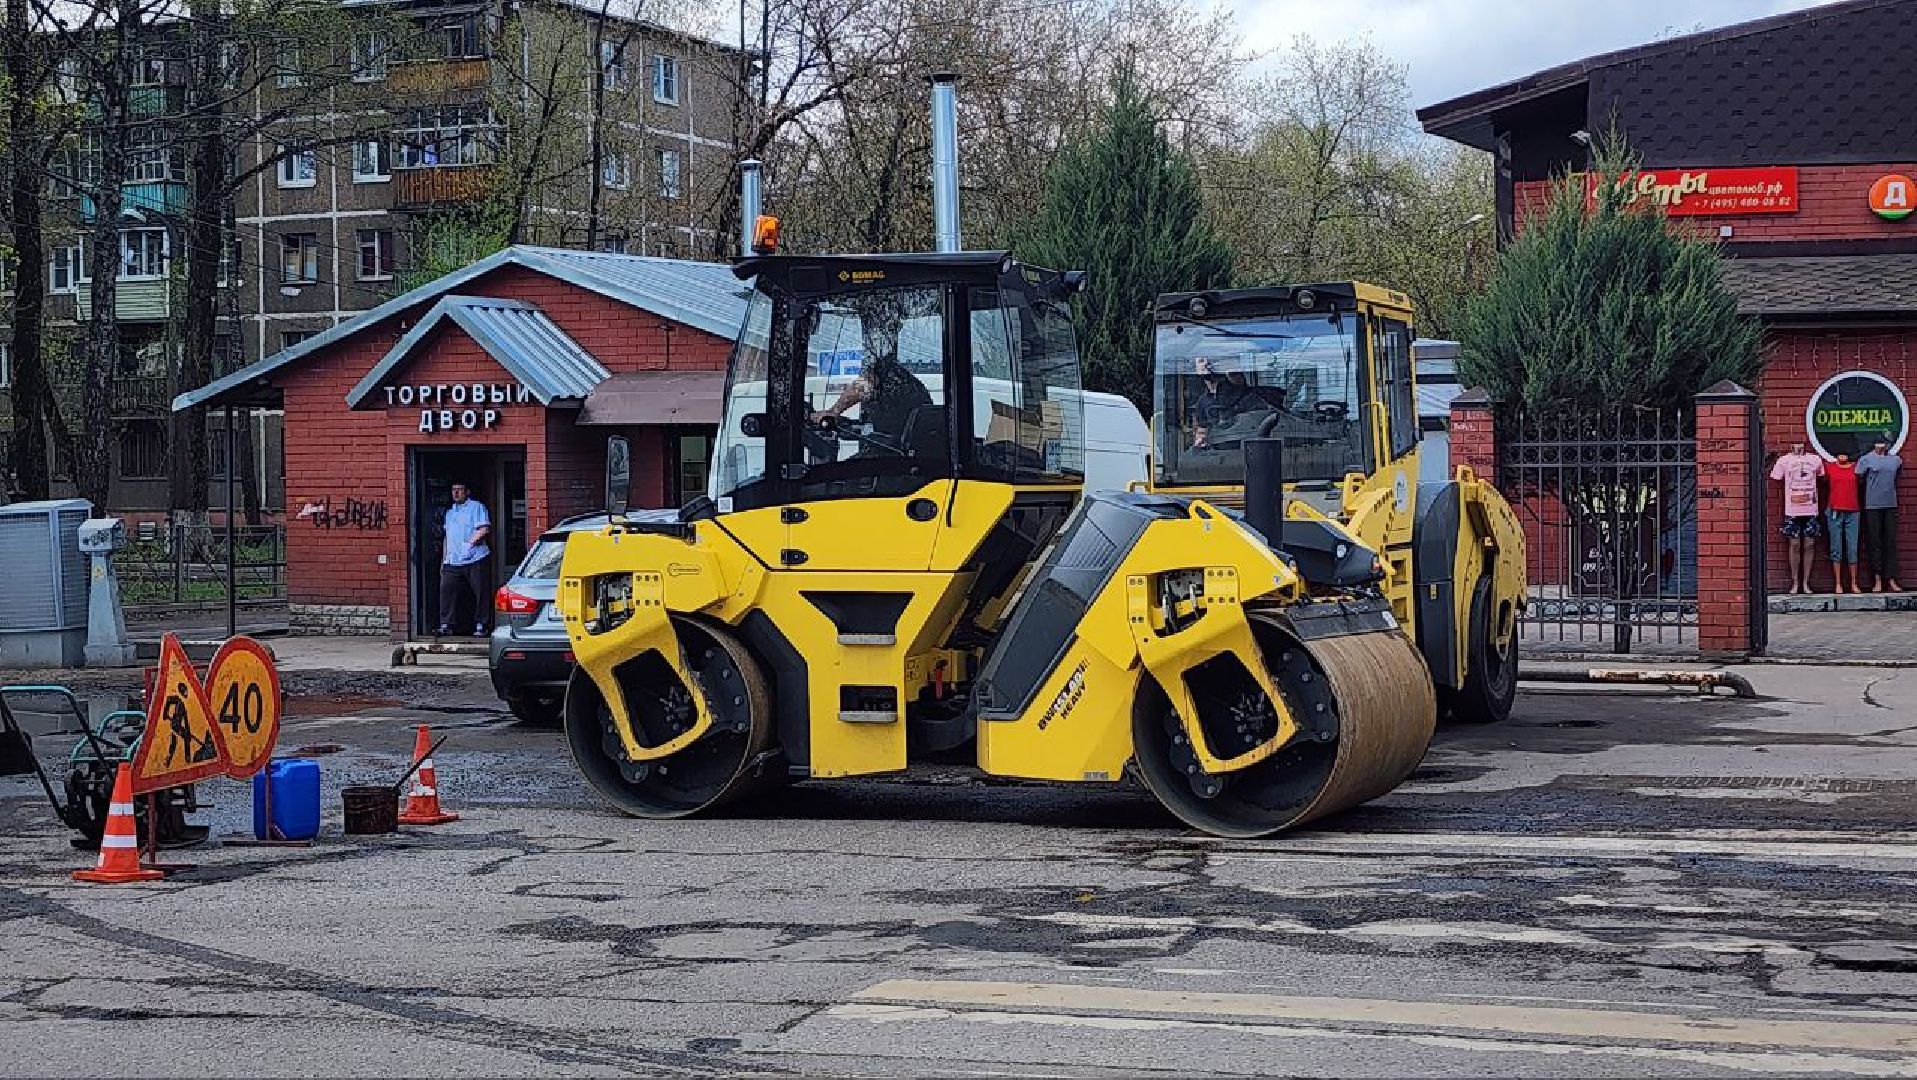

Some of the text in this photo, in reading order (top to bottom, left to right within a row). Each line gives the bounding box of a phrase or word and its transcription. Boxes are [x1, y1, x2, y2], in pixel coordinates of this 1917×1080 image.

[1884, 181, 1907, 207] Д
[419, 409, 496, 432] ДВОР
[1817, 409, 1893, 426] ОДЕЖДА
[219, 682, 263, 733] 40
[1060, 680, 1086, 719] HEAVY
